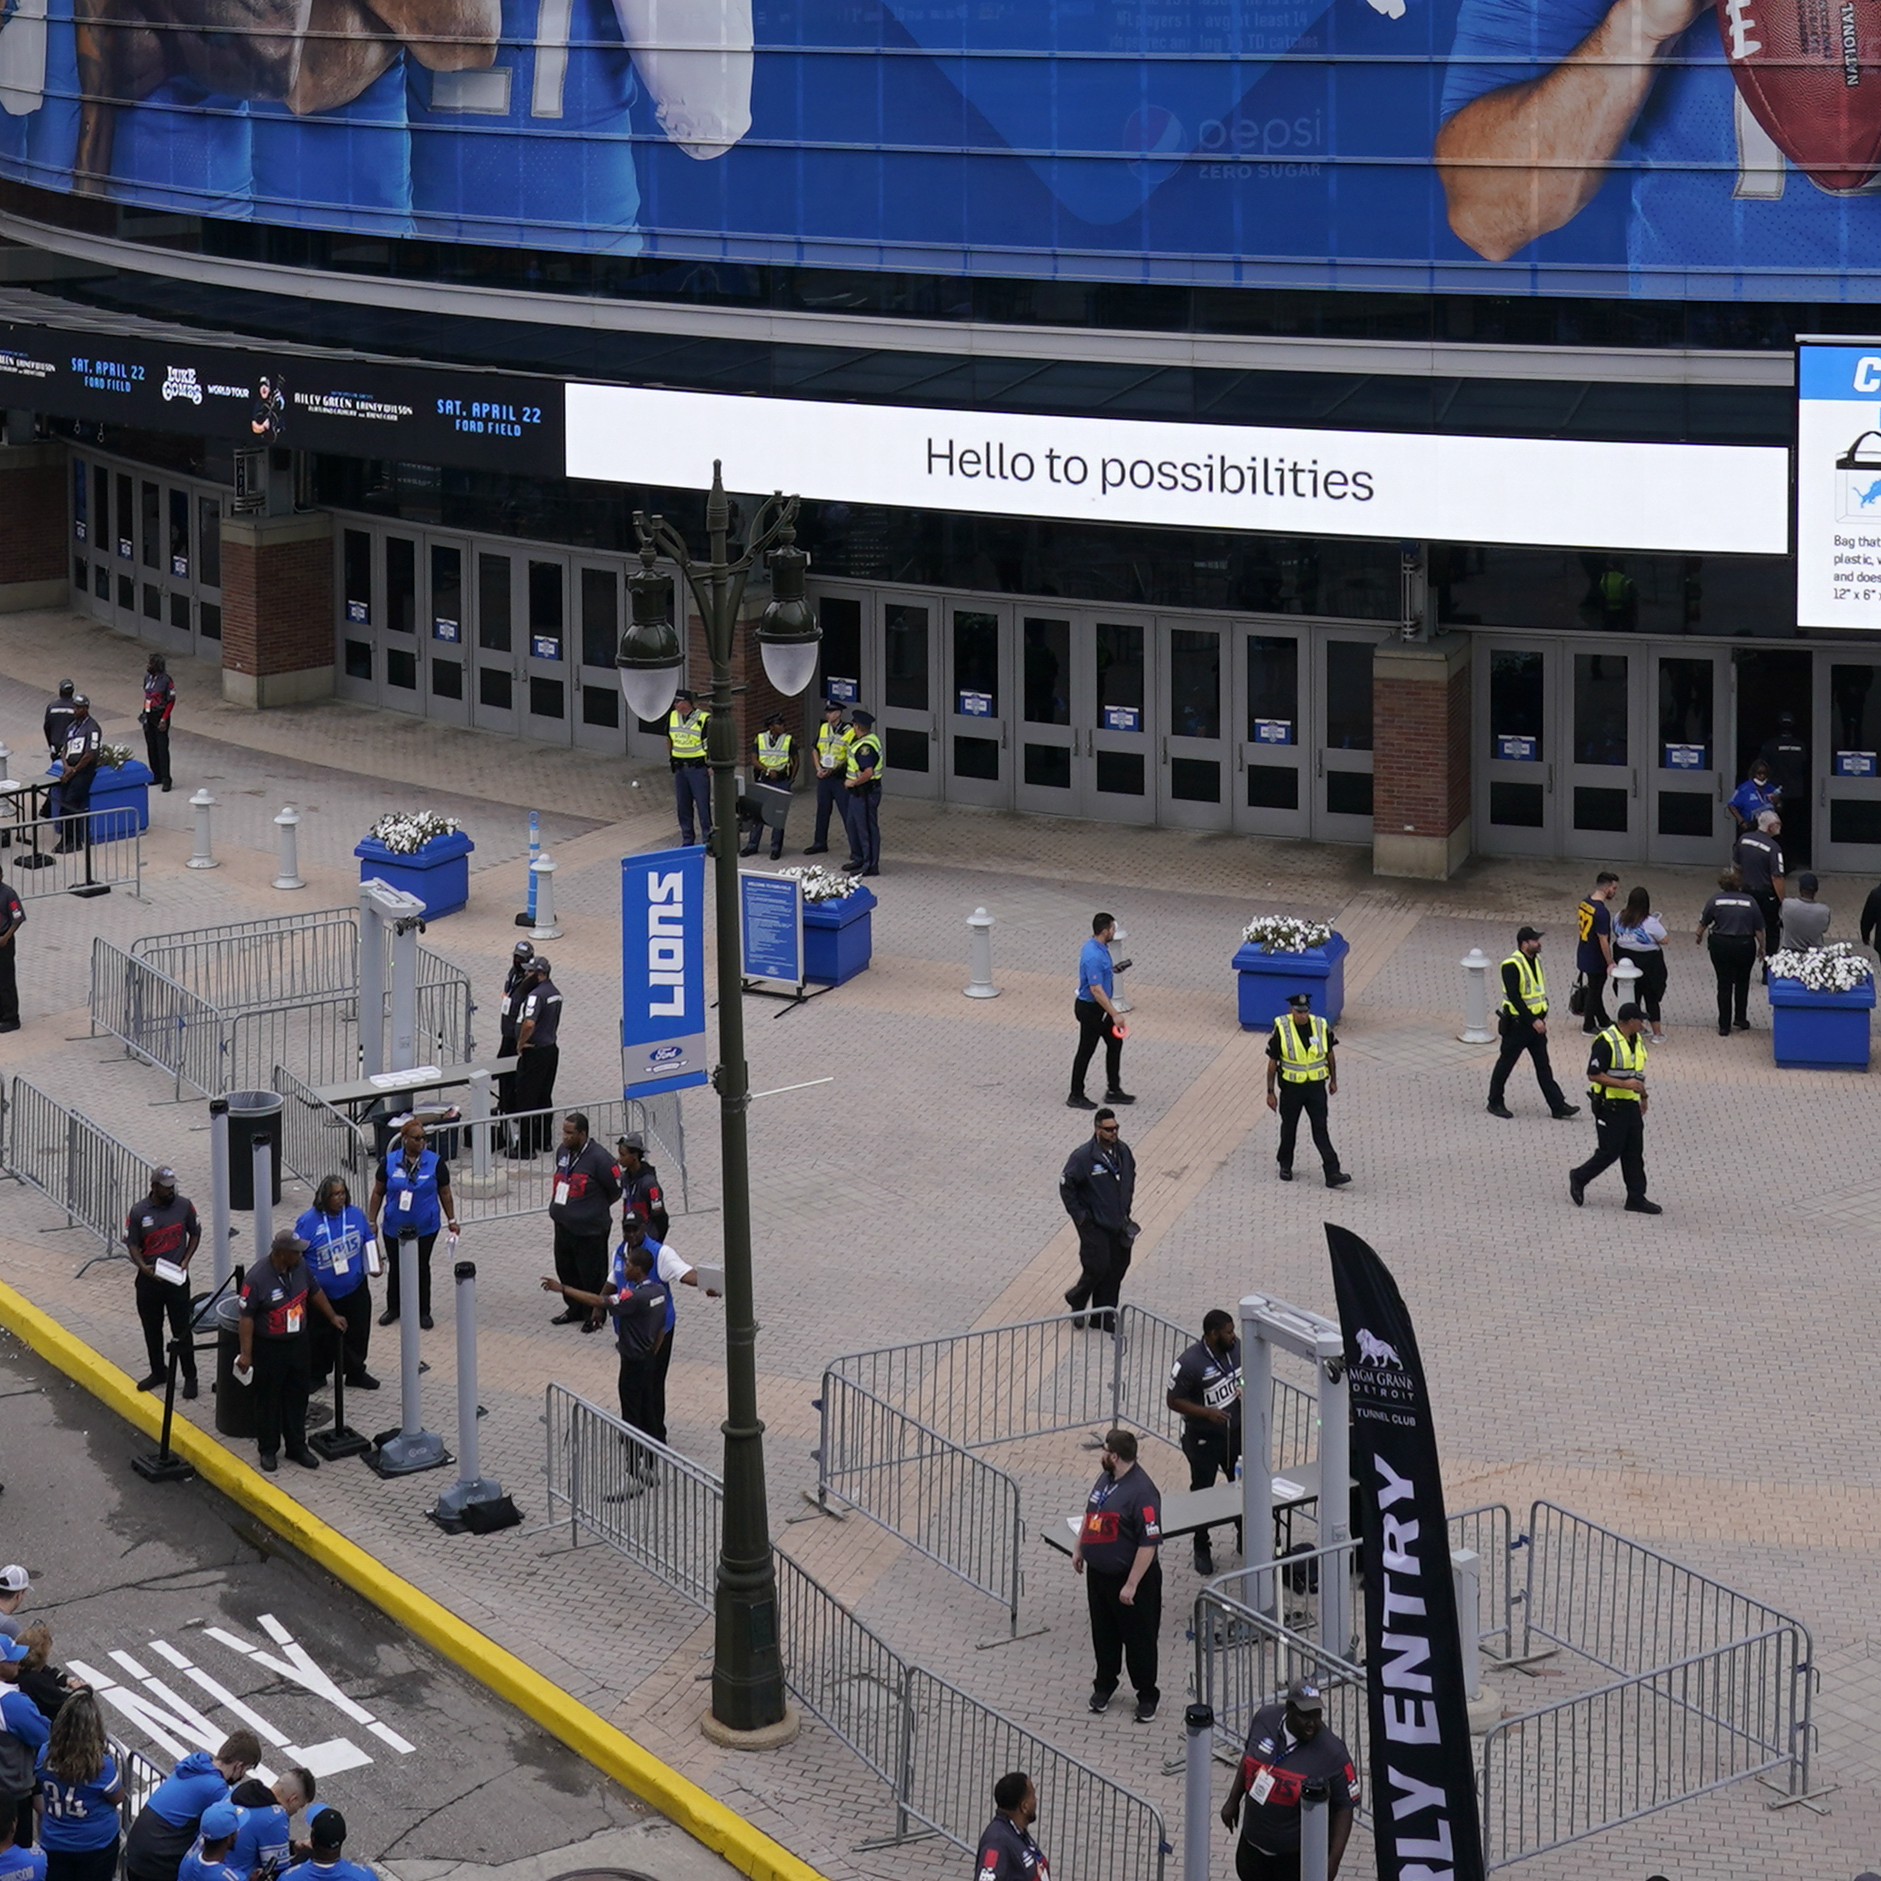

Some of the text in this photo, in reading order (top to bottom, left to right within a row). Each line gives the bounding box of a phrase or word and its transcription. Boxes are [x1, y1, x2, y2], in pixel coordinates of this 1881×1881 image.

[1840, 2, 1859, 86] NATIONAL
[71, 357, 92, 374] SAT.
[95, 361, 127, 379] APRIL
[131, 365, 145, 381] 22
[84, 375, 131, 392] FORD FIELD
[436, 398, 542, 424] SAT. APRIL 22
[455, 419, 522, 437] FORD FIELD
[926, 436, 1375, 501] Hello to possibilities
[1834, 535, 1855, 549] Bag
[1858, 536, 1881, 548] that
[1834, 553, 1874, 567] plastic,
[1833, 571, 1854, 582] and
[648, 870, 685, 1019] LIONS
[652, 1047, 679, 1060] Ford
[1349, 1368, 1414, 1390] MGM GRAND
[1352, 1383, 1414, 1400] DETROIT
[1356, 1408, 1416, 1426] TUNNEL CLUB
[1373, 1451, 1442, 1745] ENTRY
